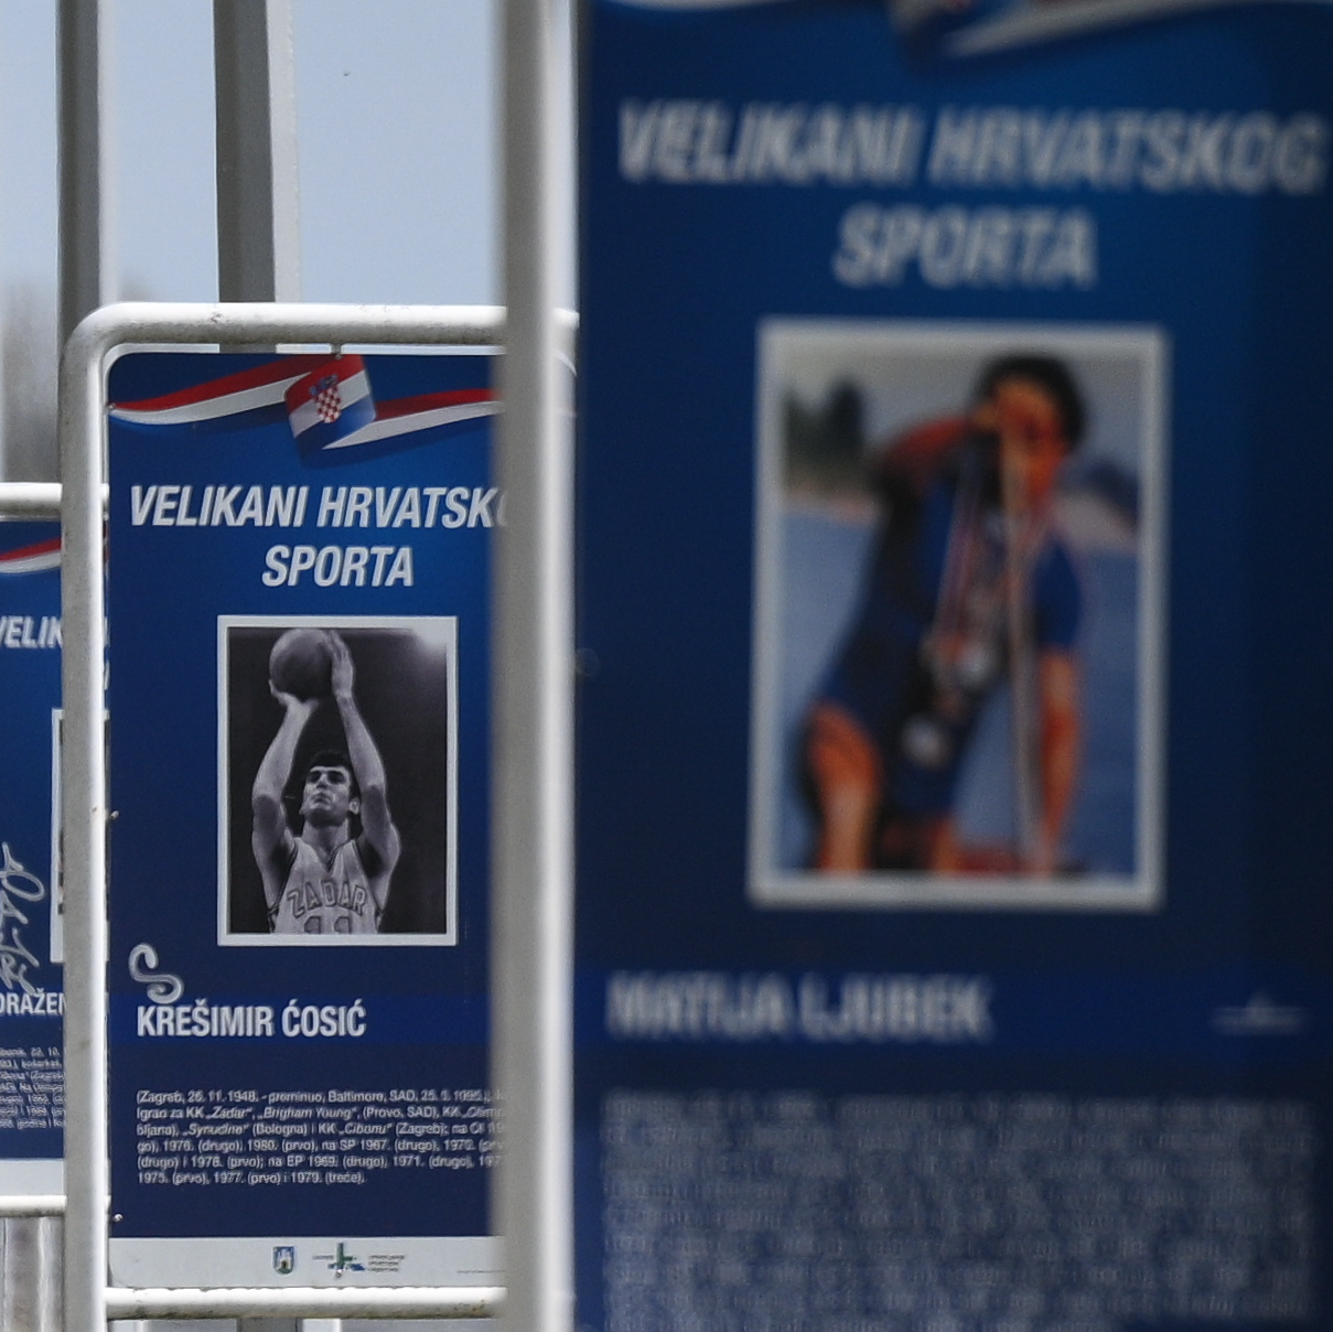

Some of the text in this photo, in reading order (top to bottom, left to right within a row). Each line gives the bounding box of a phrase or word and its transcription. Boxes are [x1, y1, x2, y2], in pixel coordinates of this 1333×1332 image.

[620, 100, 1326, 194] VELIKANI HRVATSKOG
[835, 203, 1096, 289] SPORTA
[131, 485, 508, 529] VELIKANI HRVATSK
[261, 545, 415, 587] SPORTA
[288, 878, 367, 918] ZADAR
[137, 998, 367, 1037] KREŠIMIR ĆOSIĆ
[607, 971, 993, 1043] MATIJA LJUBEK
[186, 1107, 204, 1118] KK
